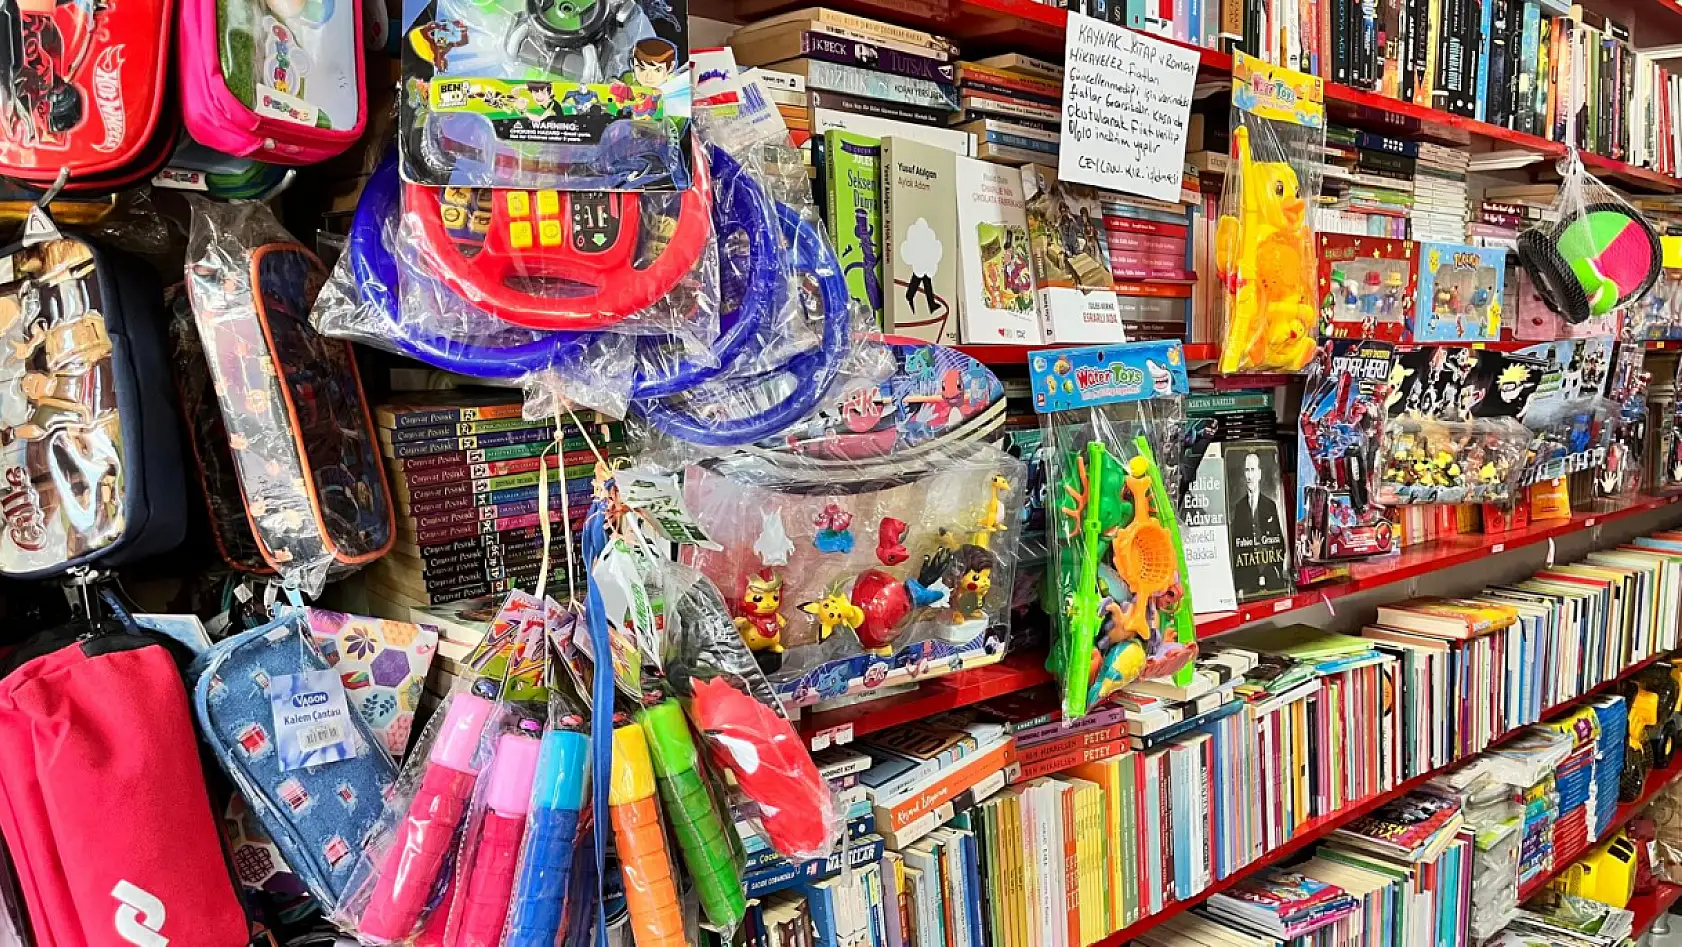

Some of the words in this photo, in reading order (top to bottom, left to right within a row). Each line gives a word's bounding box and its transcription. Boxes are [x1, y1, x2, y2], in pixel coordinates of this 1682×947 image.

[440, 83, 461, 93] BEN
[898, 162, 915, 173] Yusuf
[916, 166, 937, 181] Atılgan
[1076, 368, 1110, 390] Water
[1111, 364, 1143, 385] Toys
[1189, 478, 1220, 491] alide
[1184, 494, 1209, 508] Edib
[1185, 512, 1223, 525] Adıvar
[1235, 537, 1252, 547] Fabio
[1187, 547, 1217, 560] Bakkal
[296, 693, 327, 708] VAGON
[285, 713, 312, 726] Kalem
[313, 709, 341, 722] Çantası
[1084, 728, 1111, 744] PETEY
[1083, 745, 1110, 761] PETEY
